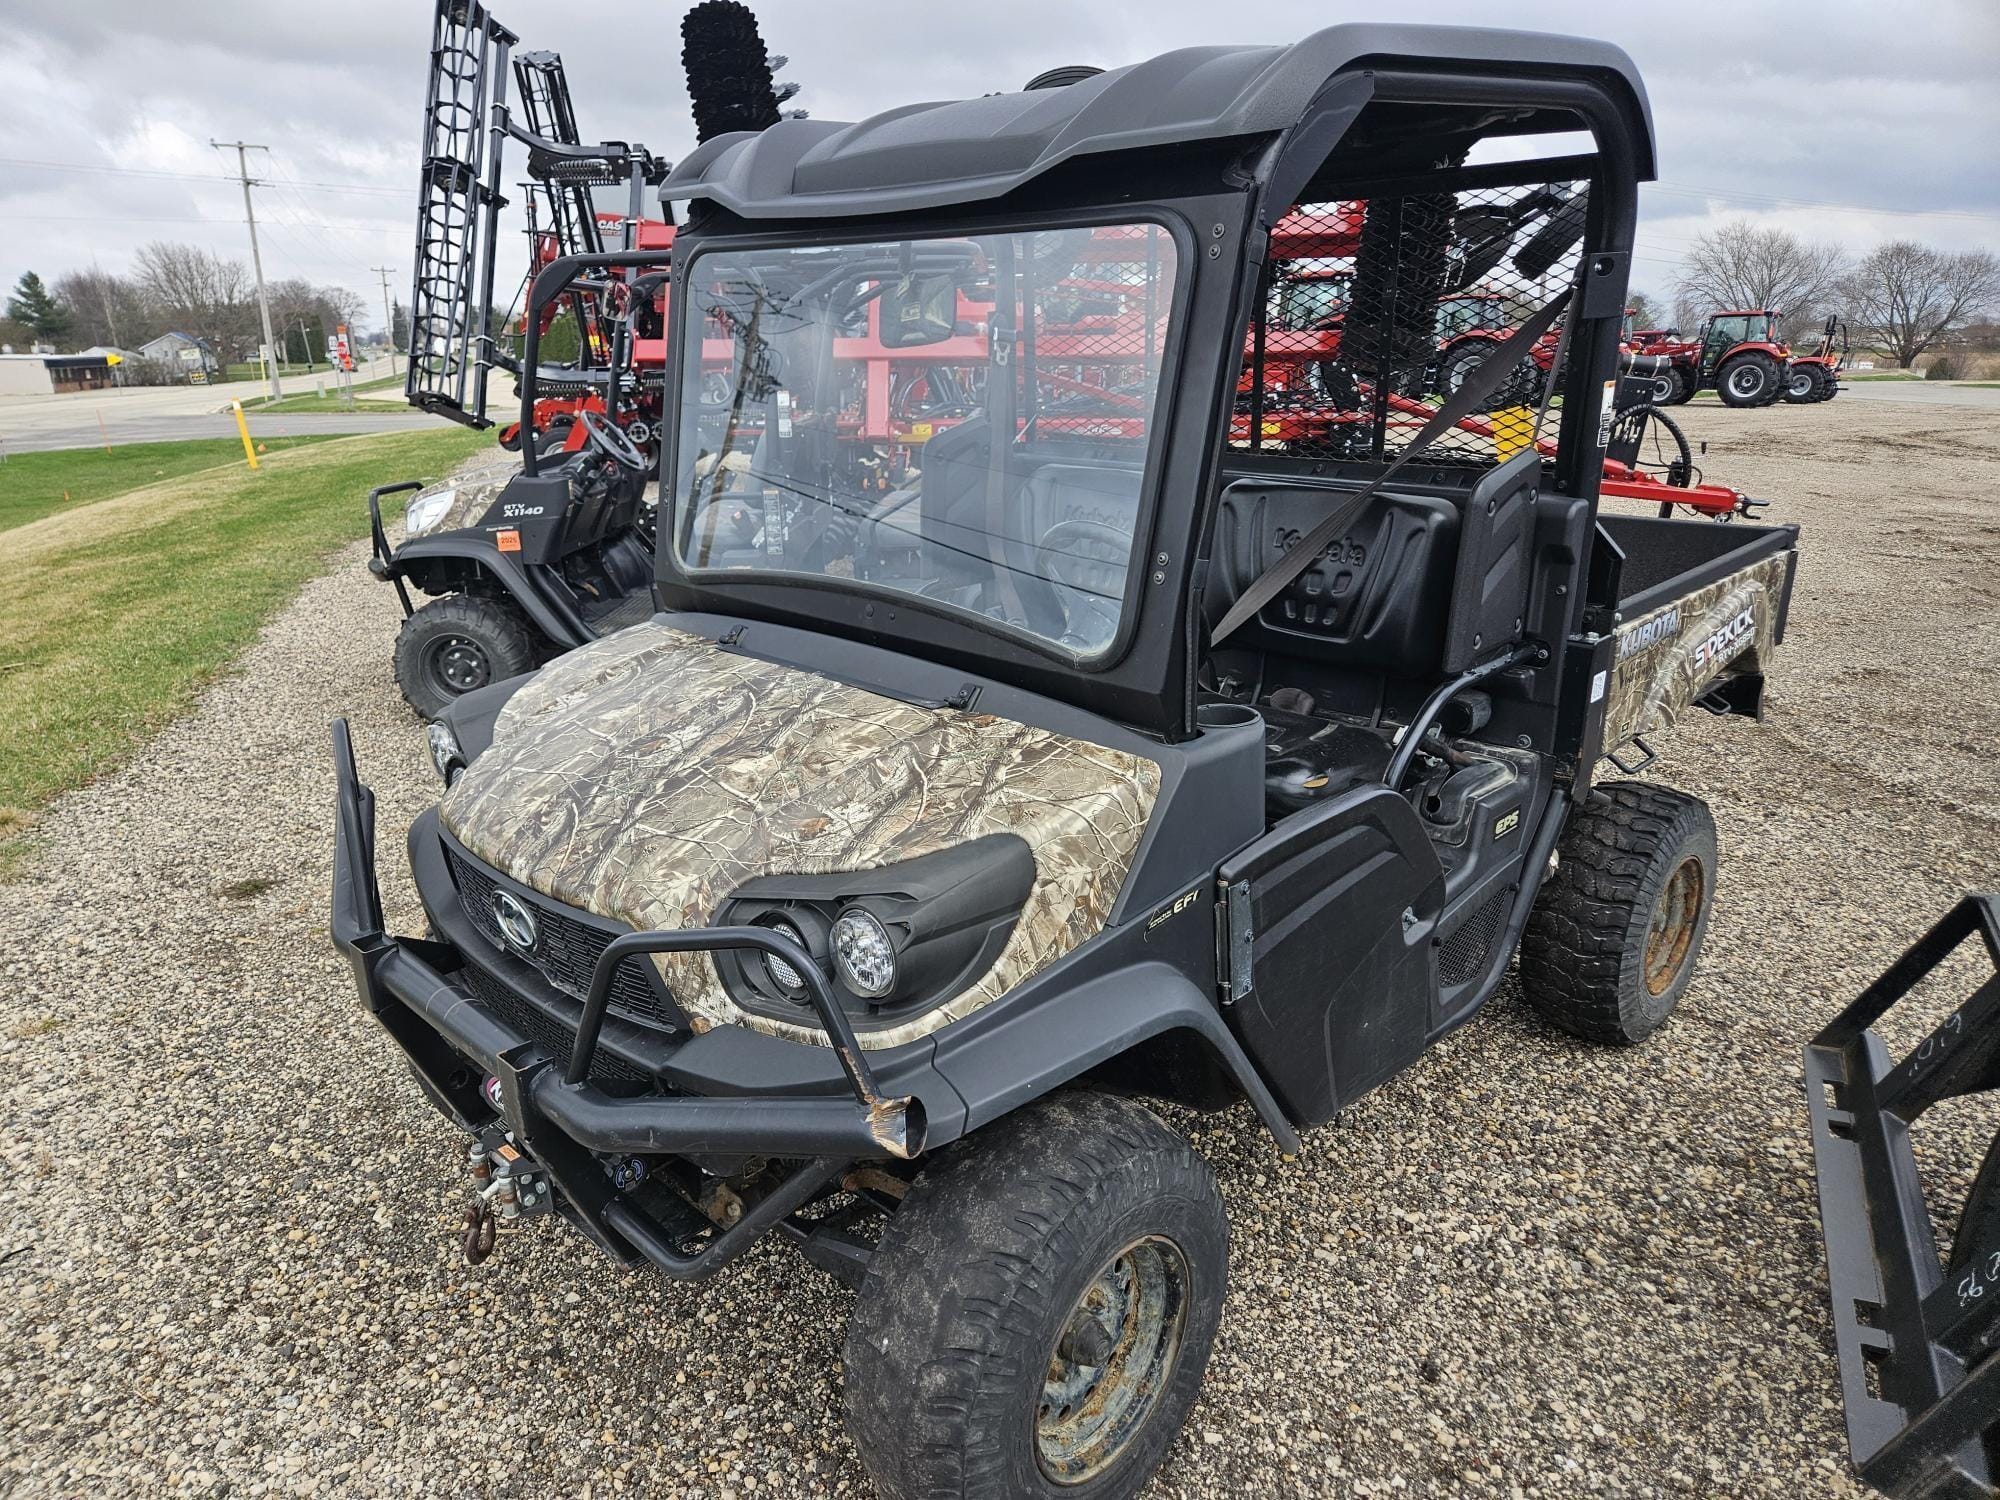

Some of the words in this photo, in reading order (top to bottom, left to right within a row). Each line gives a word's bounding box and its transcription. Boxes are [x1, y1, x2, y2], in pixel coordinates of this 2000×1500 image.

[598, 219, 623, 230] CAS
[503, 505, 545, 518] X1140
[1273, 526, 1366, 568] Kota
[1619, 609, 1678, 660] KUBOTA
[1694, 604, 1755, 670] SIDEKICK
[1495, 809, 1520, 835] EPS
[1173, 889, 1199, 914] EFI
